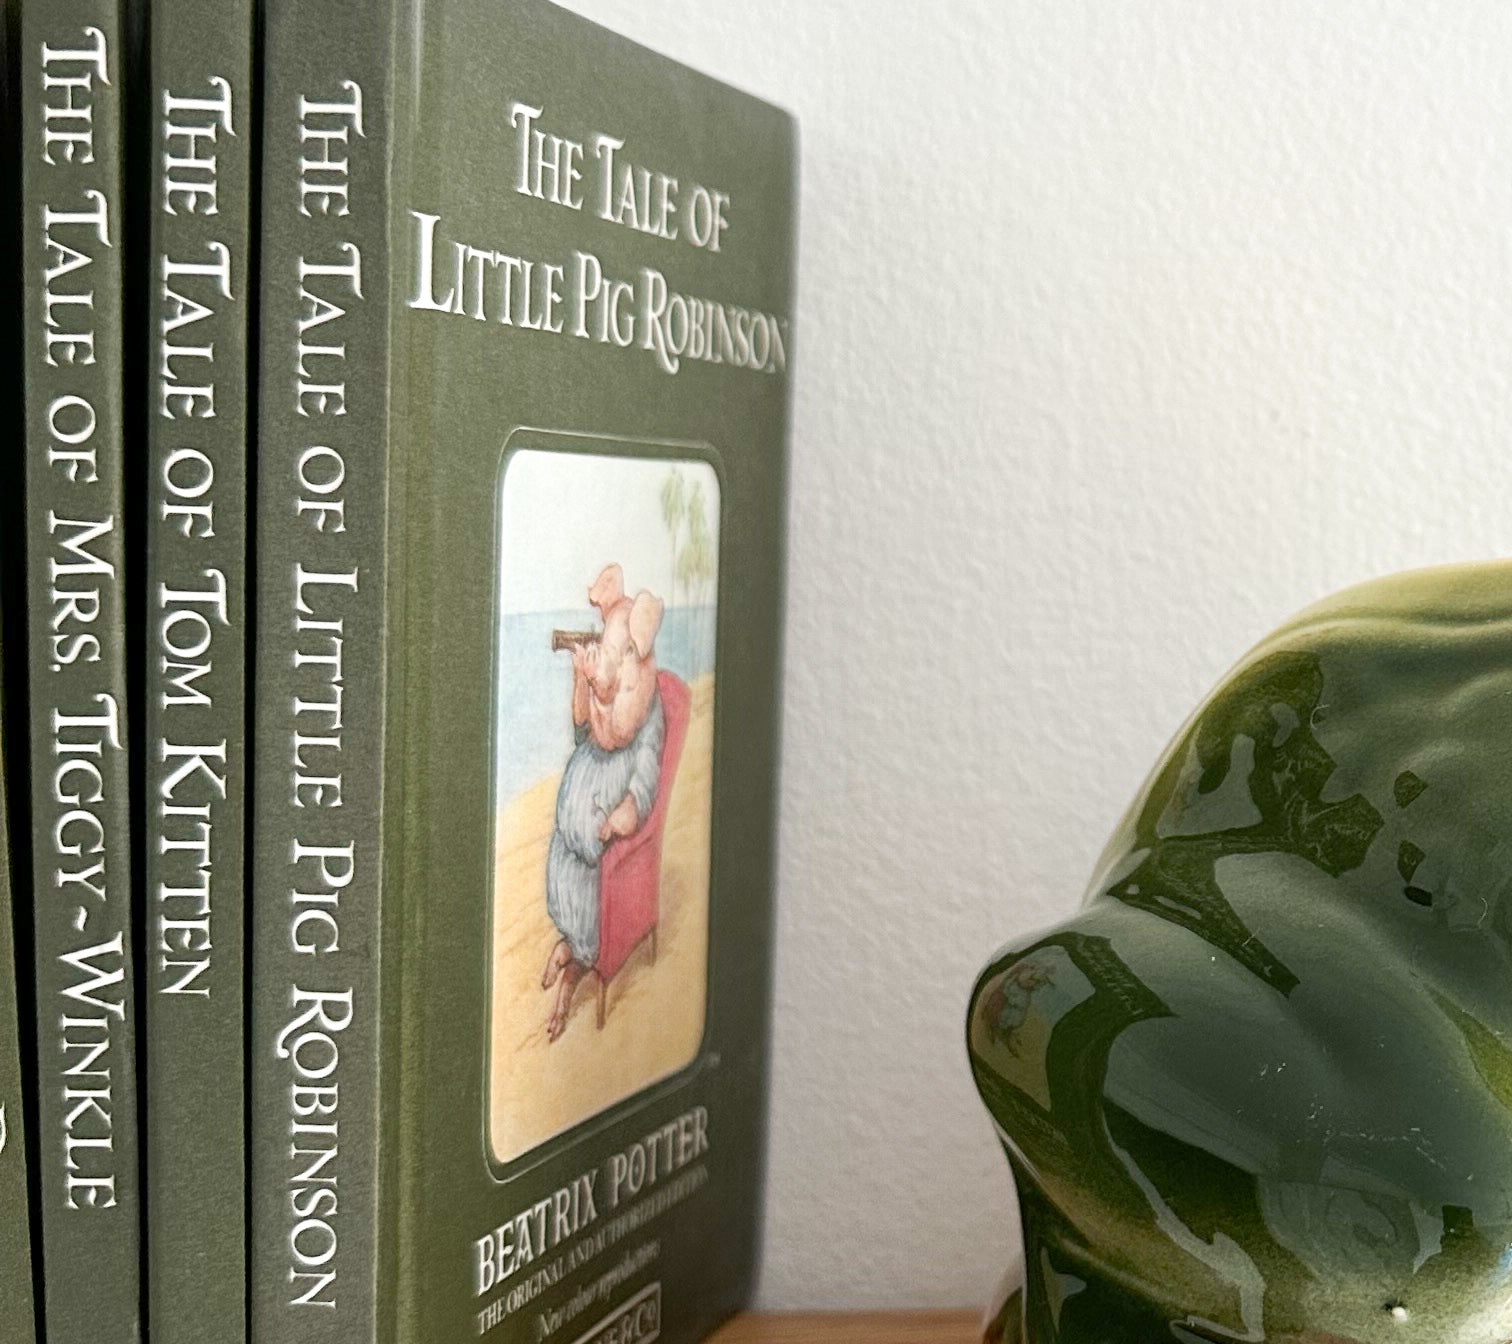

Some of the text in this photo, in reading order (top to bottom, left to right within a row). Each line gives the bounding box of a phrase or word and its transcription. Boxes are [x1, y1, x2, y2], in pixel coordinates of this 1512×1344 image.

[41, 26, 111, 166] THE
[510, 102, 731, 253] THE TALE OF
[43, 189, 113, 367] TALE
[408, 209, 789, 375] LITTLE PIG ROBINSON
[47, 395, 99, 484] OF
[48, 509, 116, 672] MRS.
[159, 75, 237, 998] THE TALE OF TOM KITTEN
[276, 79, 365, 1309] THE TALE OF LITTLE PIG ROBINSON
[476, 1168, 598, 1297] BEATRIX
[609, 1105, 709, 1207] POTTER
[477, 1306, 505, 1337] THE
[507, 1256, 564, 1313] ORIGINAL
